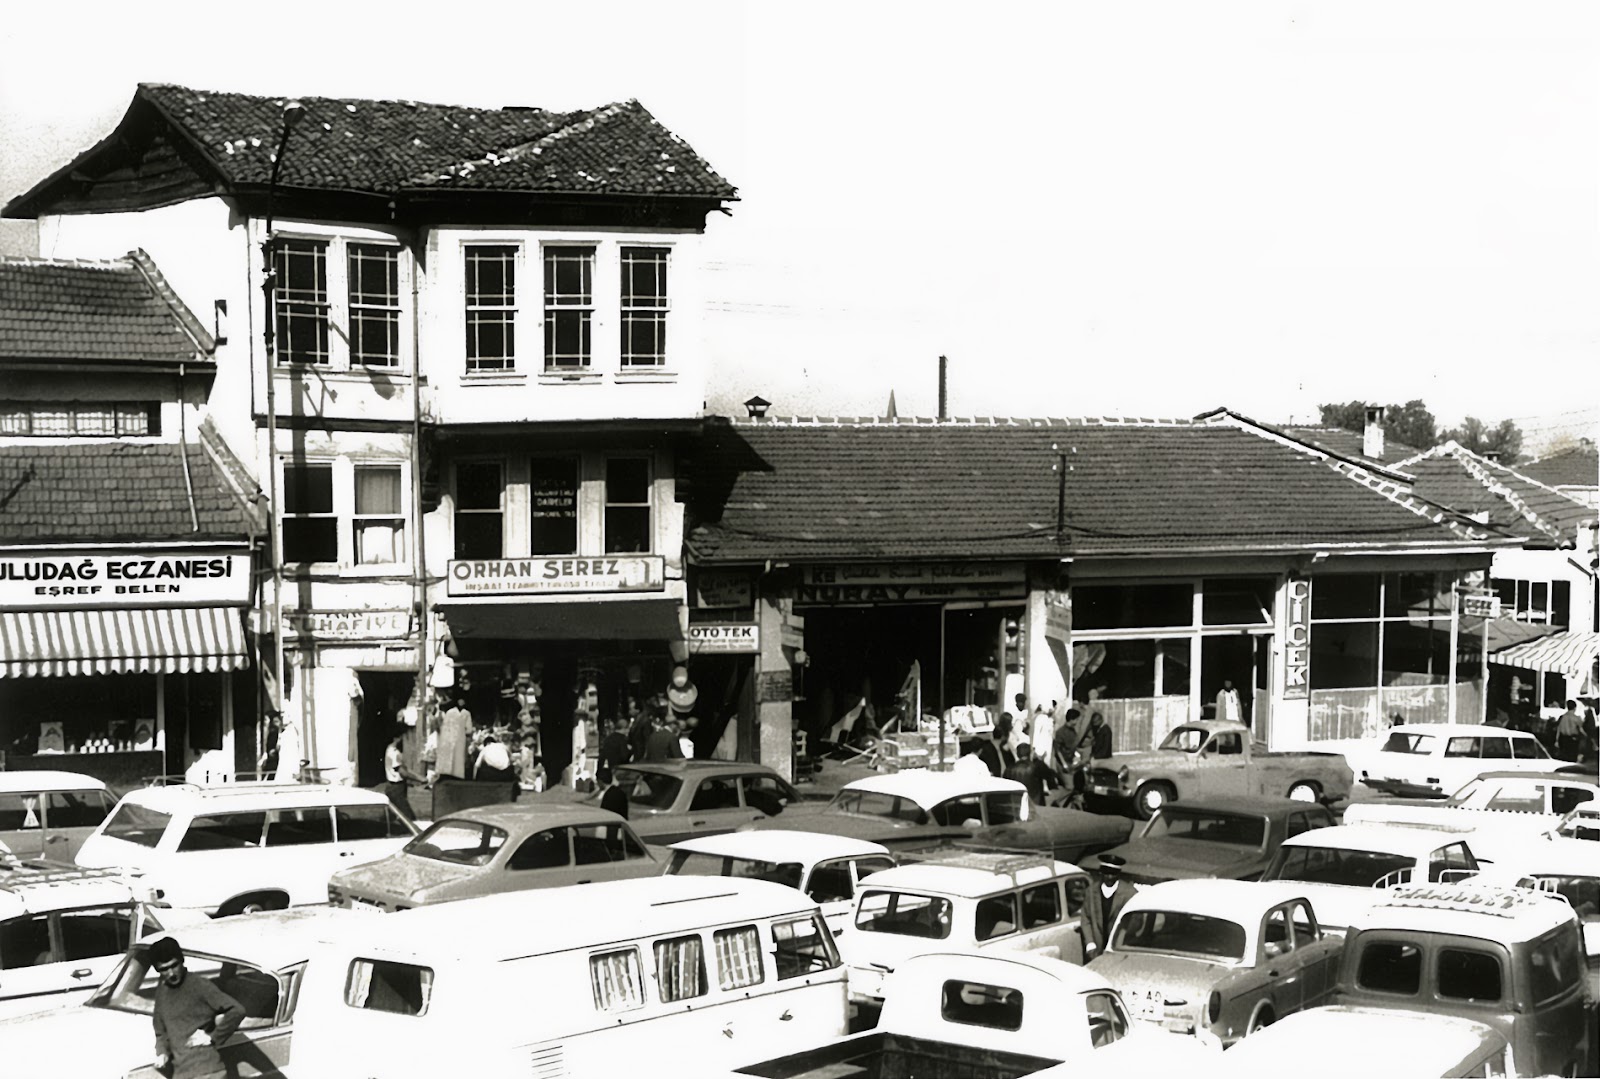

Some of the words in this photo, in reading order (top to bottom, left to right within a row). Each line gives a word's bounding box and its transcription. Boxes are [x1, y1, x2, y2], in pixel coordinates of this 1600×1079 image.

[107, 556, 232, 580] ECZANESİ
[454, 561, 532, 581] ORHAN
[543, 559, 620, 580] SEREZ
[35, 585, 102, 597] EŞREF
[115, 584, 181, 595] BELEN
[691, 627, 720, 638] OTO
[722, 627, 752, 638] TEK
